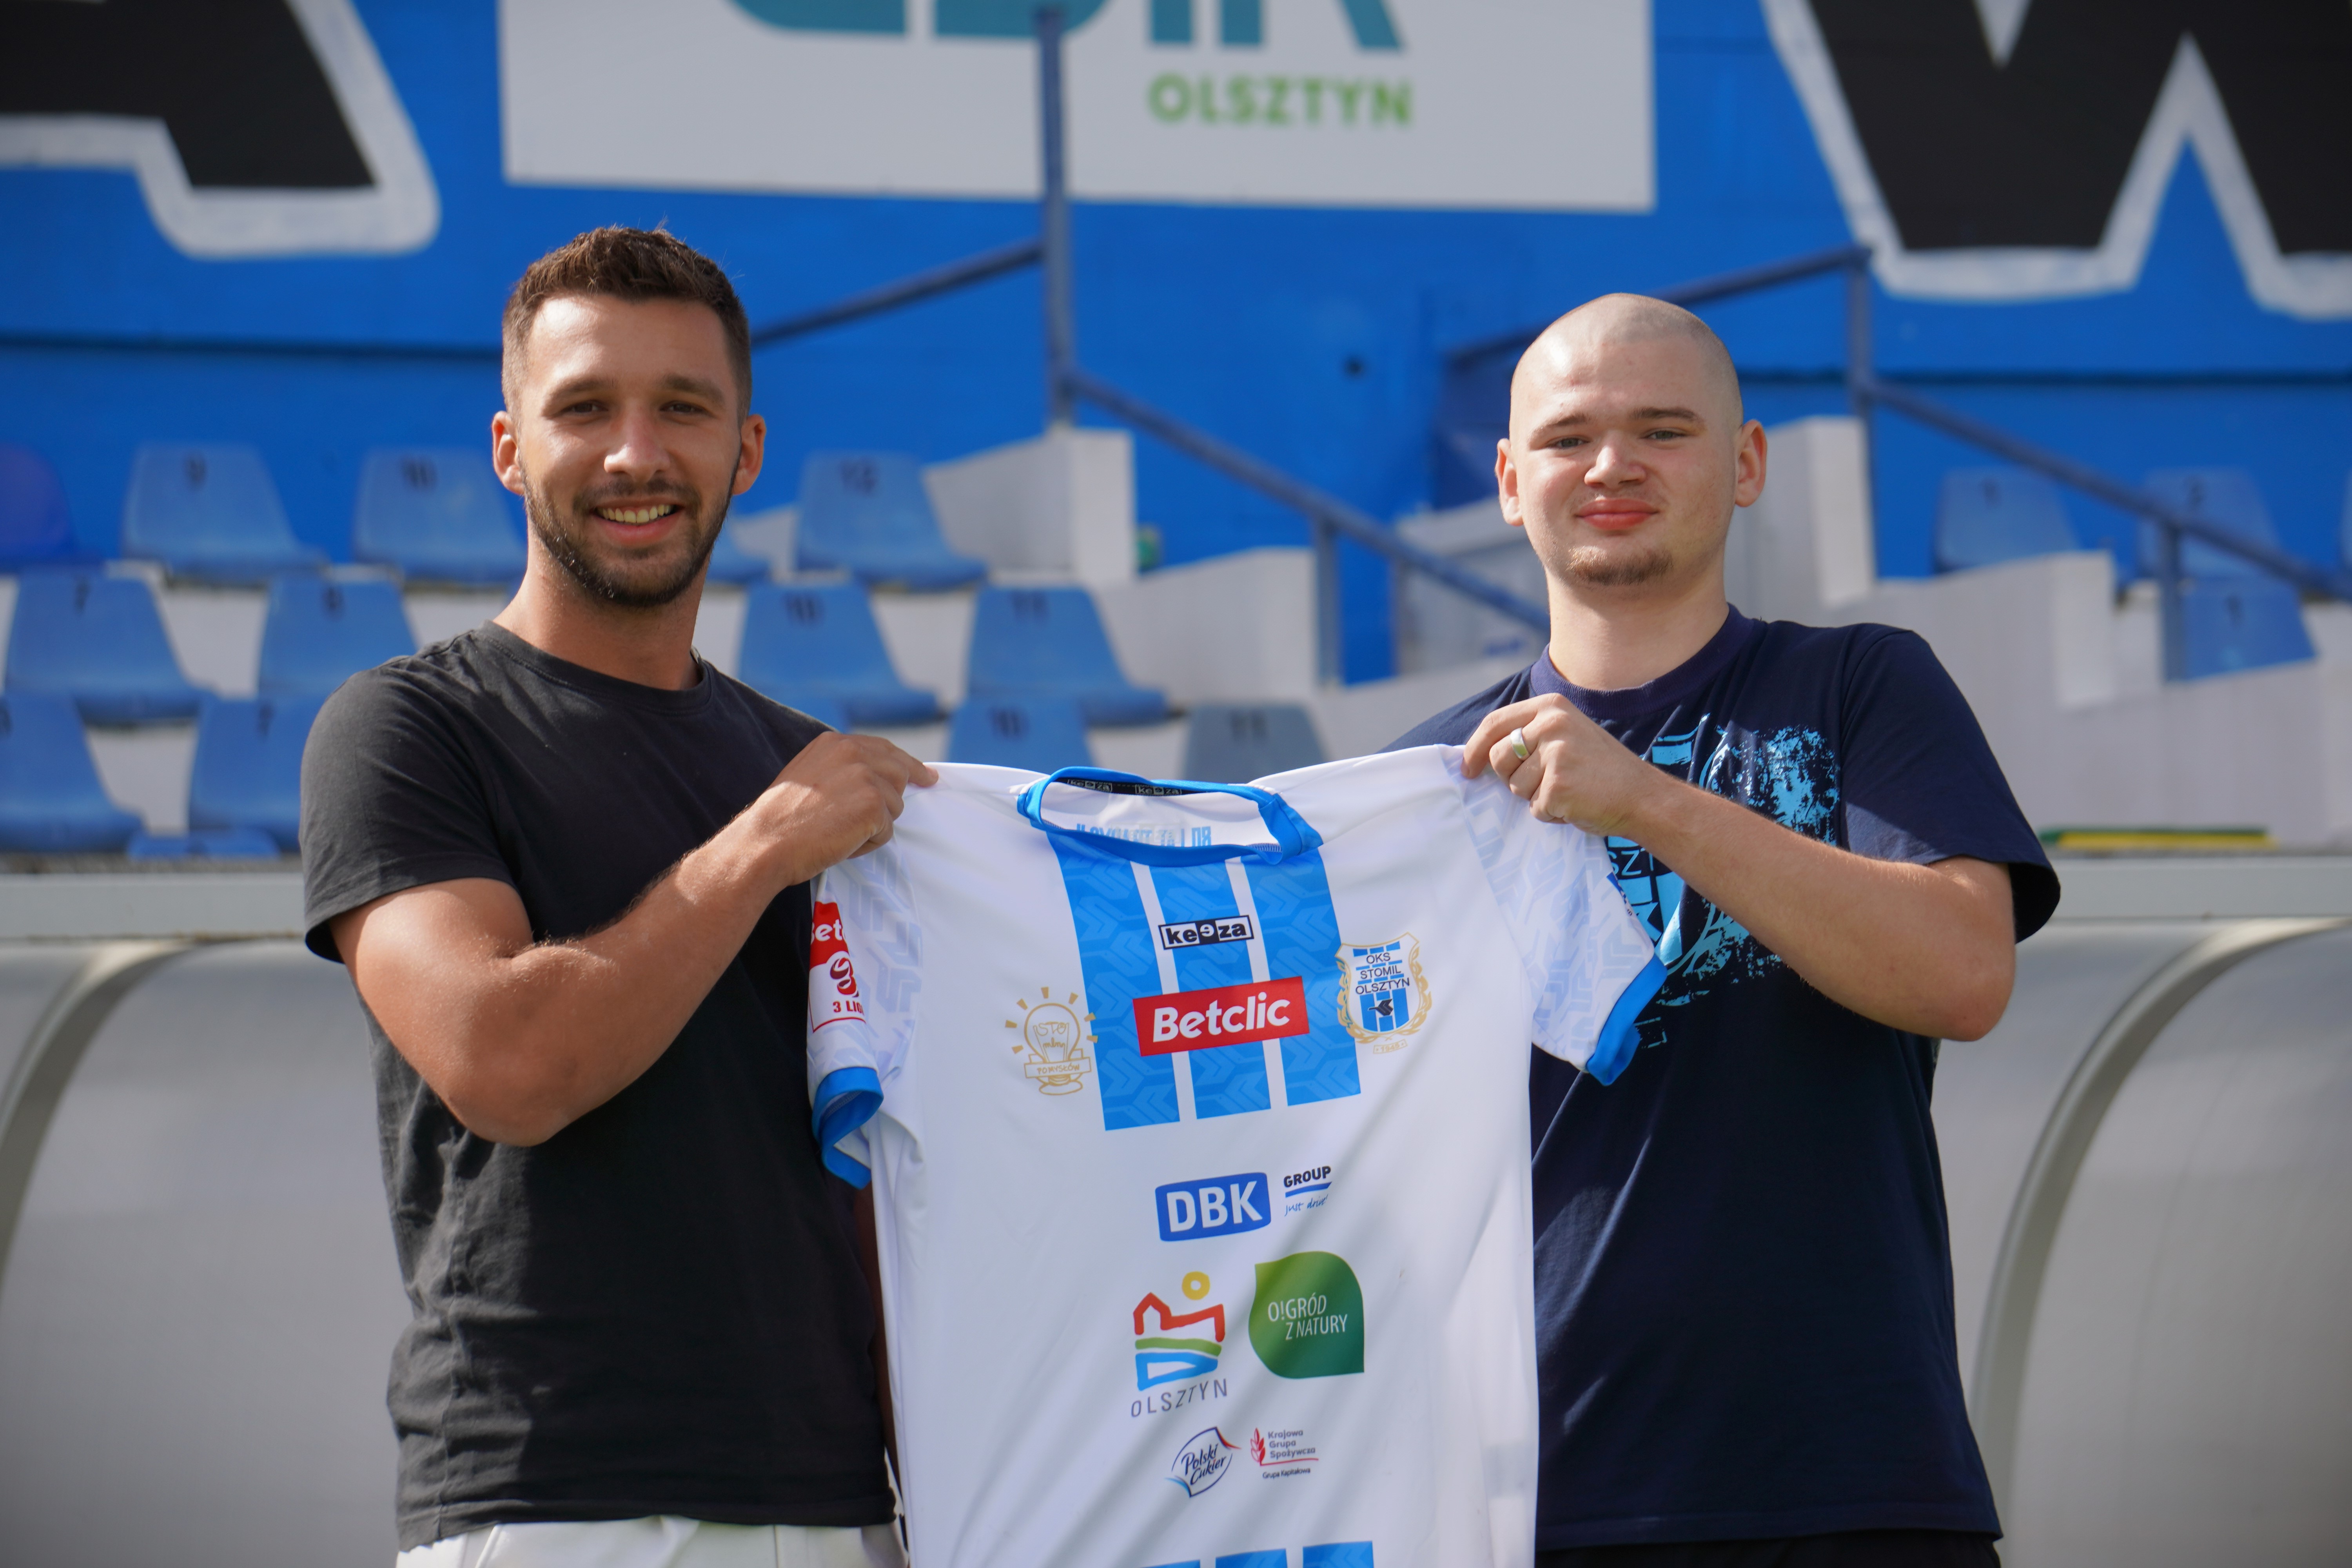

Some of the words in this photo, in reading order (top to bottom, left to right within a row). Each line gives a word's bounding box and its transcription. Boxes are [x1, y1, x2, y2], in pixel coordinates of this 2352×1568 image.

[1147, 74, 1413, 125] OLSZTYN
[1165, 923, 1247, 945] keeza
[1366, 953, 1391, 964] OKS
[1360, 965, 1401, 979] STOMIL
[1356, 978, 1410, 995] OLSZTYN
[833, 1001, 841, 1013] 3
[1153, 991, 1290, 1042] Betclic
[1037, 1063, 1080, 1074] POMYSŁÓW
[1284, 1165, 1331, 1188] GROUP
[1167, 1180, 1263, 1233] DBK
[1284, 1202, 1304, 1217] just
[1268, 1292, 1327, 1322] O!GRÓD
[1285, 1321, 1293, 1340] Z
[1296, 1314, 1348, 1338] NATURY
[1131, 1378, 1227, 1418] OLSZTYN
[1268, 1430, 1303, 1440] Krajowa
[1269, 1440, 1296, 1449] Grupa
[1181, 1443, 1219, 1476] Polski
[1270, 1447, 1316, 1460] Spożywcza
[1190, 1456, 1227, 1485] Cukier
[1262, 1471, 1280, 1479] Grupa
